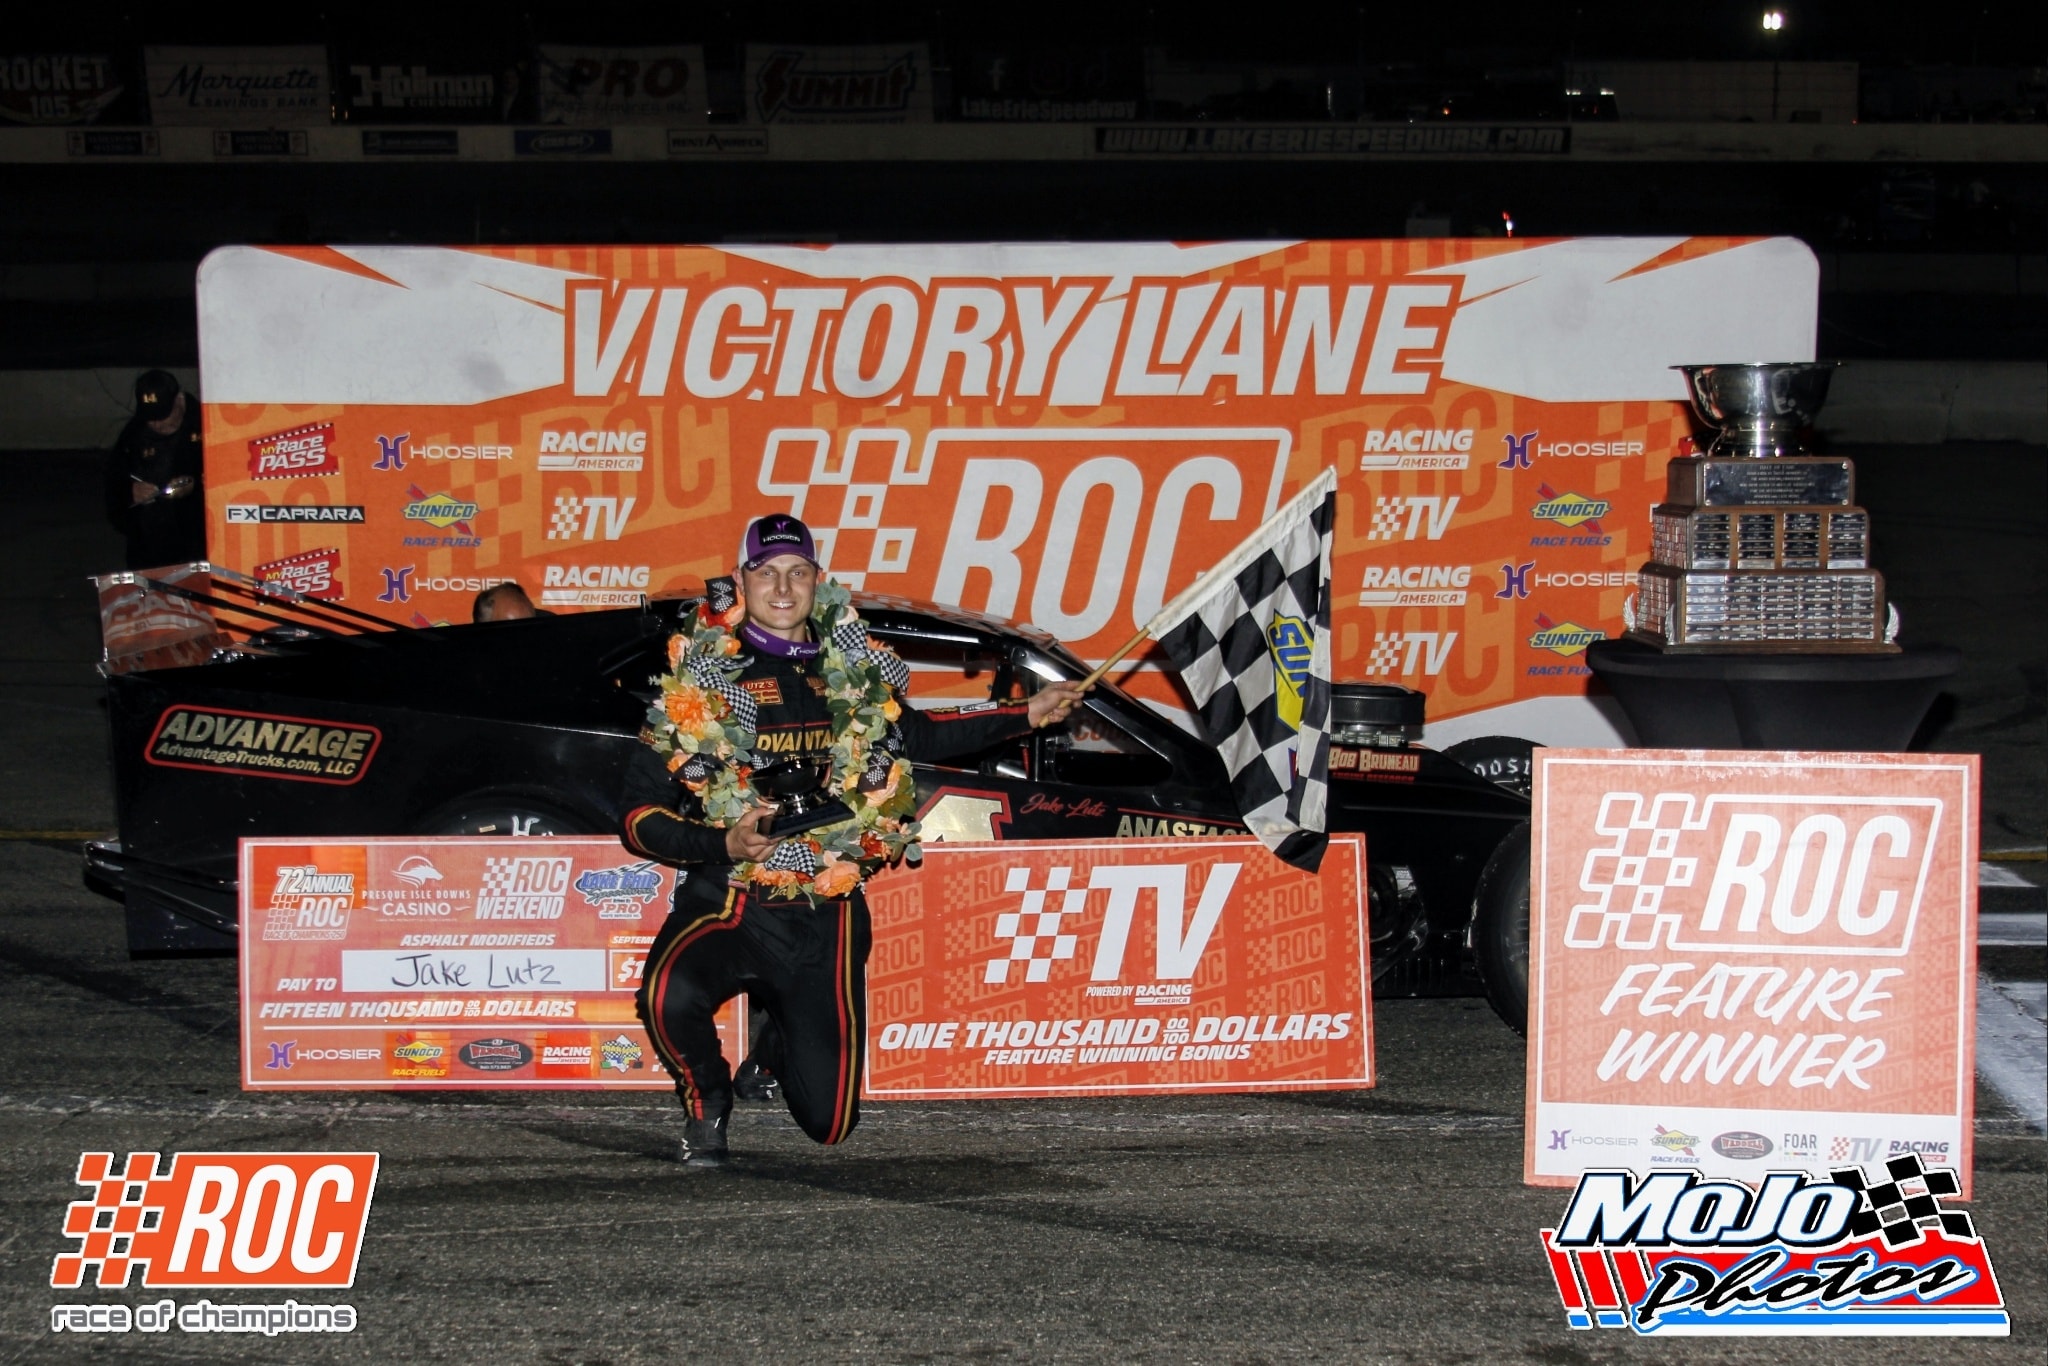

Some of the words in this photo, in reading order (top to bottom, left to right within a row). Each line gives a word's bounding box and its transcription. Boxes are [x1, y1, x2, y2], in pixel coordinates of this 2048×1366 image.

[157, 64, 320, 107] Marquette
[566, 57, 690, 99] PRO
[30, 95, 70, 119] 105
[204, 97, 269, 108] SAVINGS
[276, 96, 319, 108] BANK
[574, 286, 1096, 399] VICTORY
[1114, 285, 1452, 396] LANE
[540, 431, 647, 453] RACING
[1363, 429, 1475, 452] RACING
[410, 445, 513, 460] HOOSIER
[1537, 442, 1644, 457] HOOSIER
[258, 447, 327, 473] PASS
[261, 508, 364, 521] CAPRARA
[408, 503, 476, 519] SUNOCO
[582, 497, 637, 541] TV
[1403, 496, 1461, 541] TV
[1536, 503, 1607, 519] SUNOCO
[402, 537, 439, 547] RACE
[441, 537, 482, 548] FUELS
[762, 534, 801, 543] HOOSIER
[1530, 537, 1568, 547] RACE
[1569, 536, 1612, 547] FUELS
[931, 456, 1243, 642] ROC
[543, 566, 650, 588] RACING
[1361, 565, 1472, 588] RACING
[1534, 572, 1641, 587] HOOSIER
[1531, 632, 1603, 647] SUNOCO
[1400, 632, 1458, 676] TV
[1527, 665, 1565, 676] RACE
[159, 711, 373, 761] ADVANTAGE
[156, 742, 321, 774] AdvantageTrucks.com,
[326, 759, 357, 775] LLC
[513, 860, 566, 894] ROC
[580, 872, 619, 889] LAKE
[1699, 813, 1912, 937] ROC
[301, 875, 352, 893] ANNUAL
[362, 890, 407, 900] PRESQUE
[410, 890, 432, 899] ISLE
[436, 889, 471, 899] DOWNS
[296, 897, 348, 928] ROC
[382, 902, 451, 916] CASINO
[475, 897, 565, 920] WEEKEND
[604, 904, 641, 914] PRO
[1084, 862, 1244, 982] TV
[400, 934, 468, 947] ASPHALT
[470, 933, 555, 946] MODIFIEDS
[611, 935, 656, 945] SEPTEM
[391, 953, 472, 988] Jake
[487, 953, 562, 988] Lutz
[276, 978, 314, 992] PAY
[315, 977, 337, 991] TO
[1085, 986, 1122, 997] POWERED
[1122, 986, 1134, 996] BY
[1136, 984, 1193, 996] RACING
[1599, 961, 1905, 1025] FEATURE
[260, 1002, 344, 1019] FIFTEEN
[349, 1001, 465, 1018] THOUSAND
[482, 1001, 576, 1018] DOLLARS
[879, 1022, 960, 1050] ONE
[964, 1017, 1161, 1049] THOUSAND
[1166, 1017, 1188, 1030] 00
[1192, 1013, 1352, 1044] DOLLARS
[1162, 1033, 1190, 1045] 100
[296, 1048, 382, 1060] HOOSIER
[396, 1047, 442, 1058] SUNOCO
[543, 1046, 592, 1057] RACING
[983, 1048, 1077, 1066] FEATURE
[1077, 1044, 1179, 1064] WINNING
[1179, 1044, 1252, 1062] BONUS
[1595, 1028, 1887, 1090] WINNER
[392, 1068, 418, 1077] RACE
[418, 1068, 447, 1077] FUELS
[1571, 1135, 1639, 1147] HOOSIER
[1653, 1135, 1698, 1147] SUNOCO
[1783, 1133, 1818, 1149] FOAR
[1888, 1140, 1950, 1153] RACING
[1849, 1137, 1883, 1163] TV
[1650, 1155, 1674, 1163] RACE
[1674, 1156, 1701, 1164] FUELS
